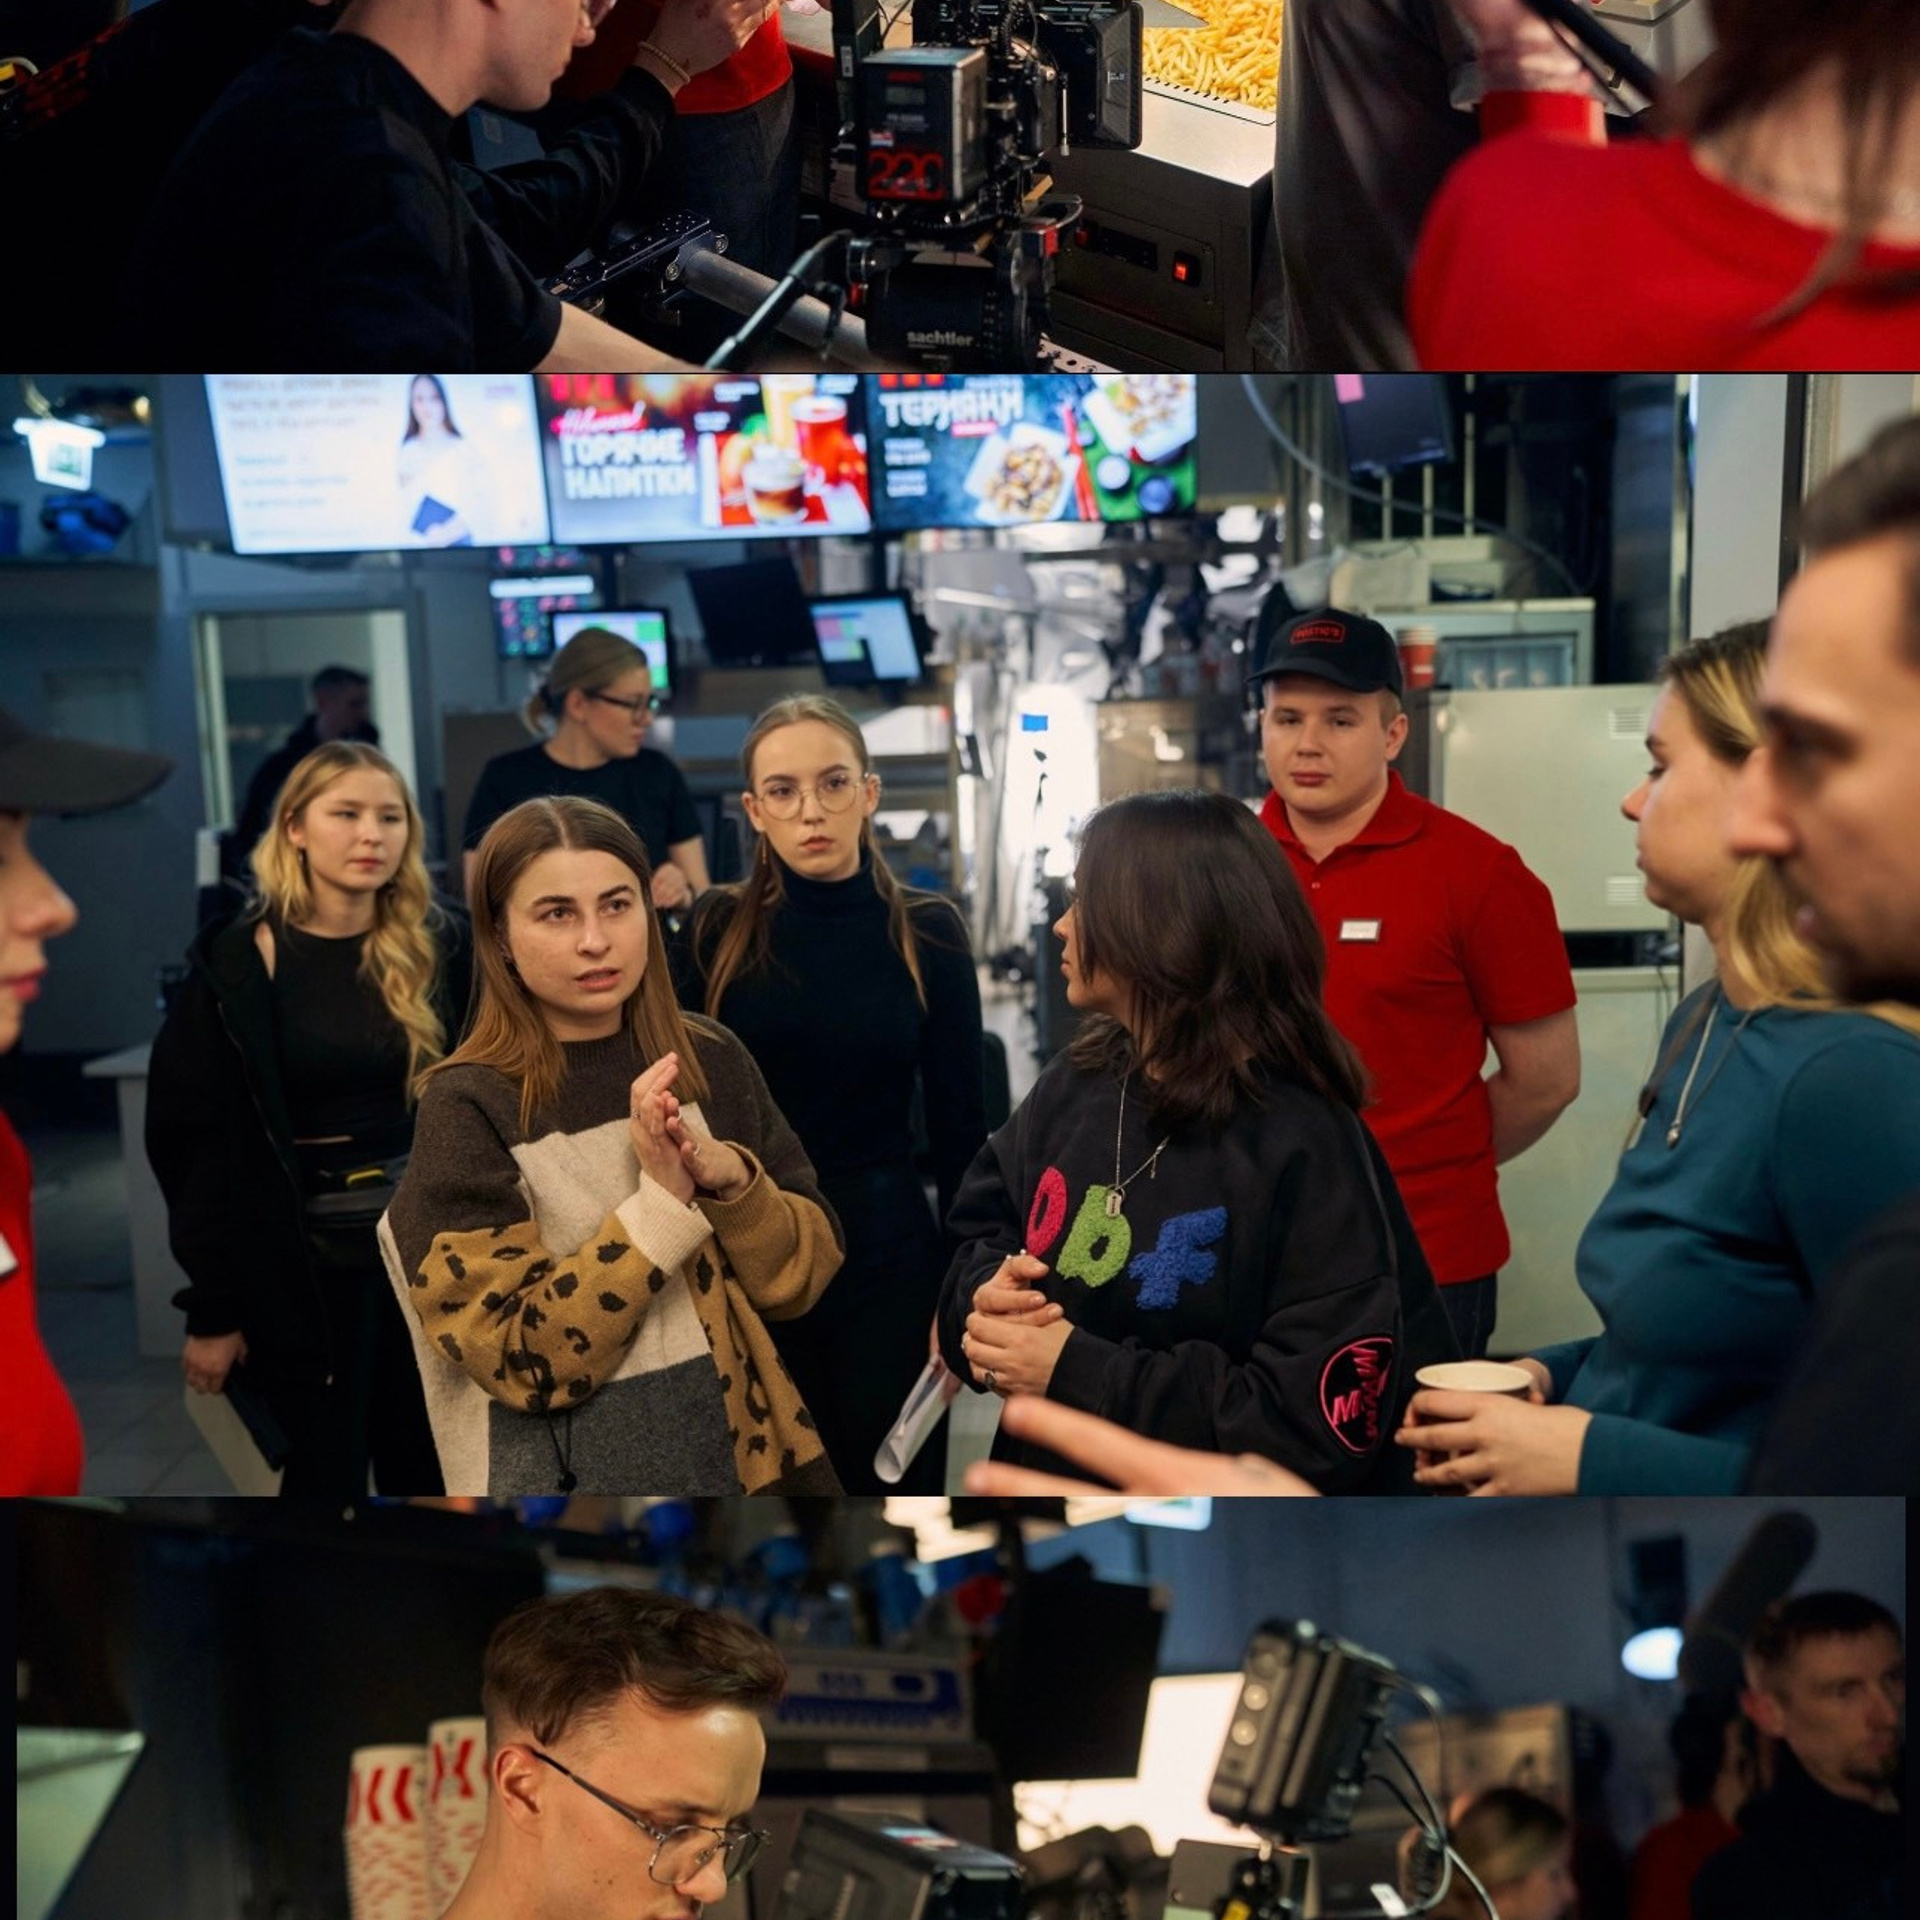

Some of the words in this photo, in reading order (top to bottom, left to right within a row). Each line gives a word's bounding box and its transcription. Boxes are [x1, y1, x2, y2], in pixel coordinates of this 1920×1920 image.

[867, 150, 947, 199] 220
[907, 330, 973, 346] sachtler
[559, 428, 686, 466] ГОРЯЧИЕ
[564, 464, 696, 499] НАПИТКИ
